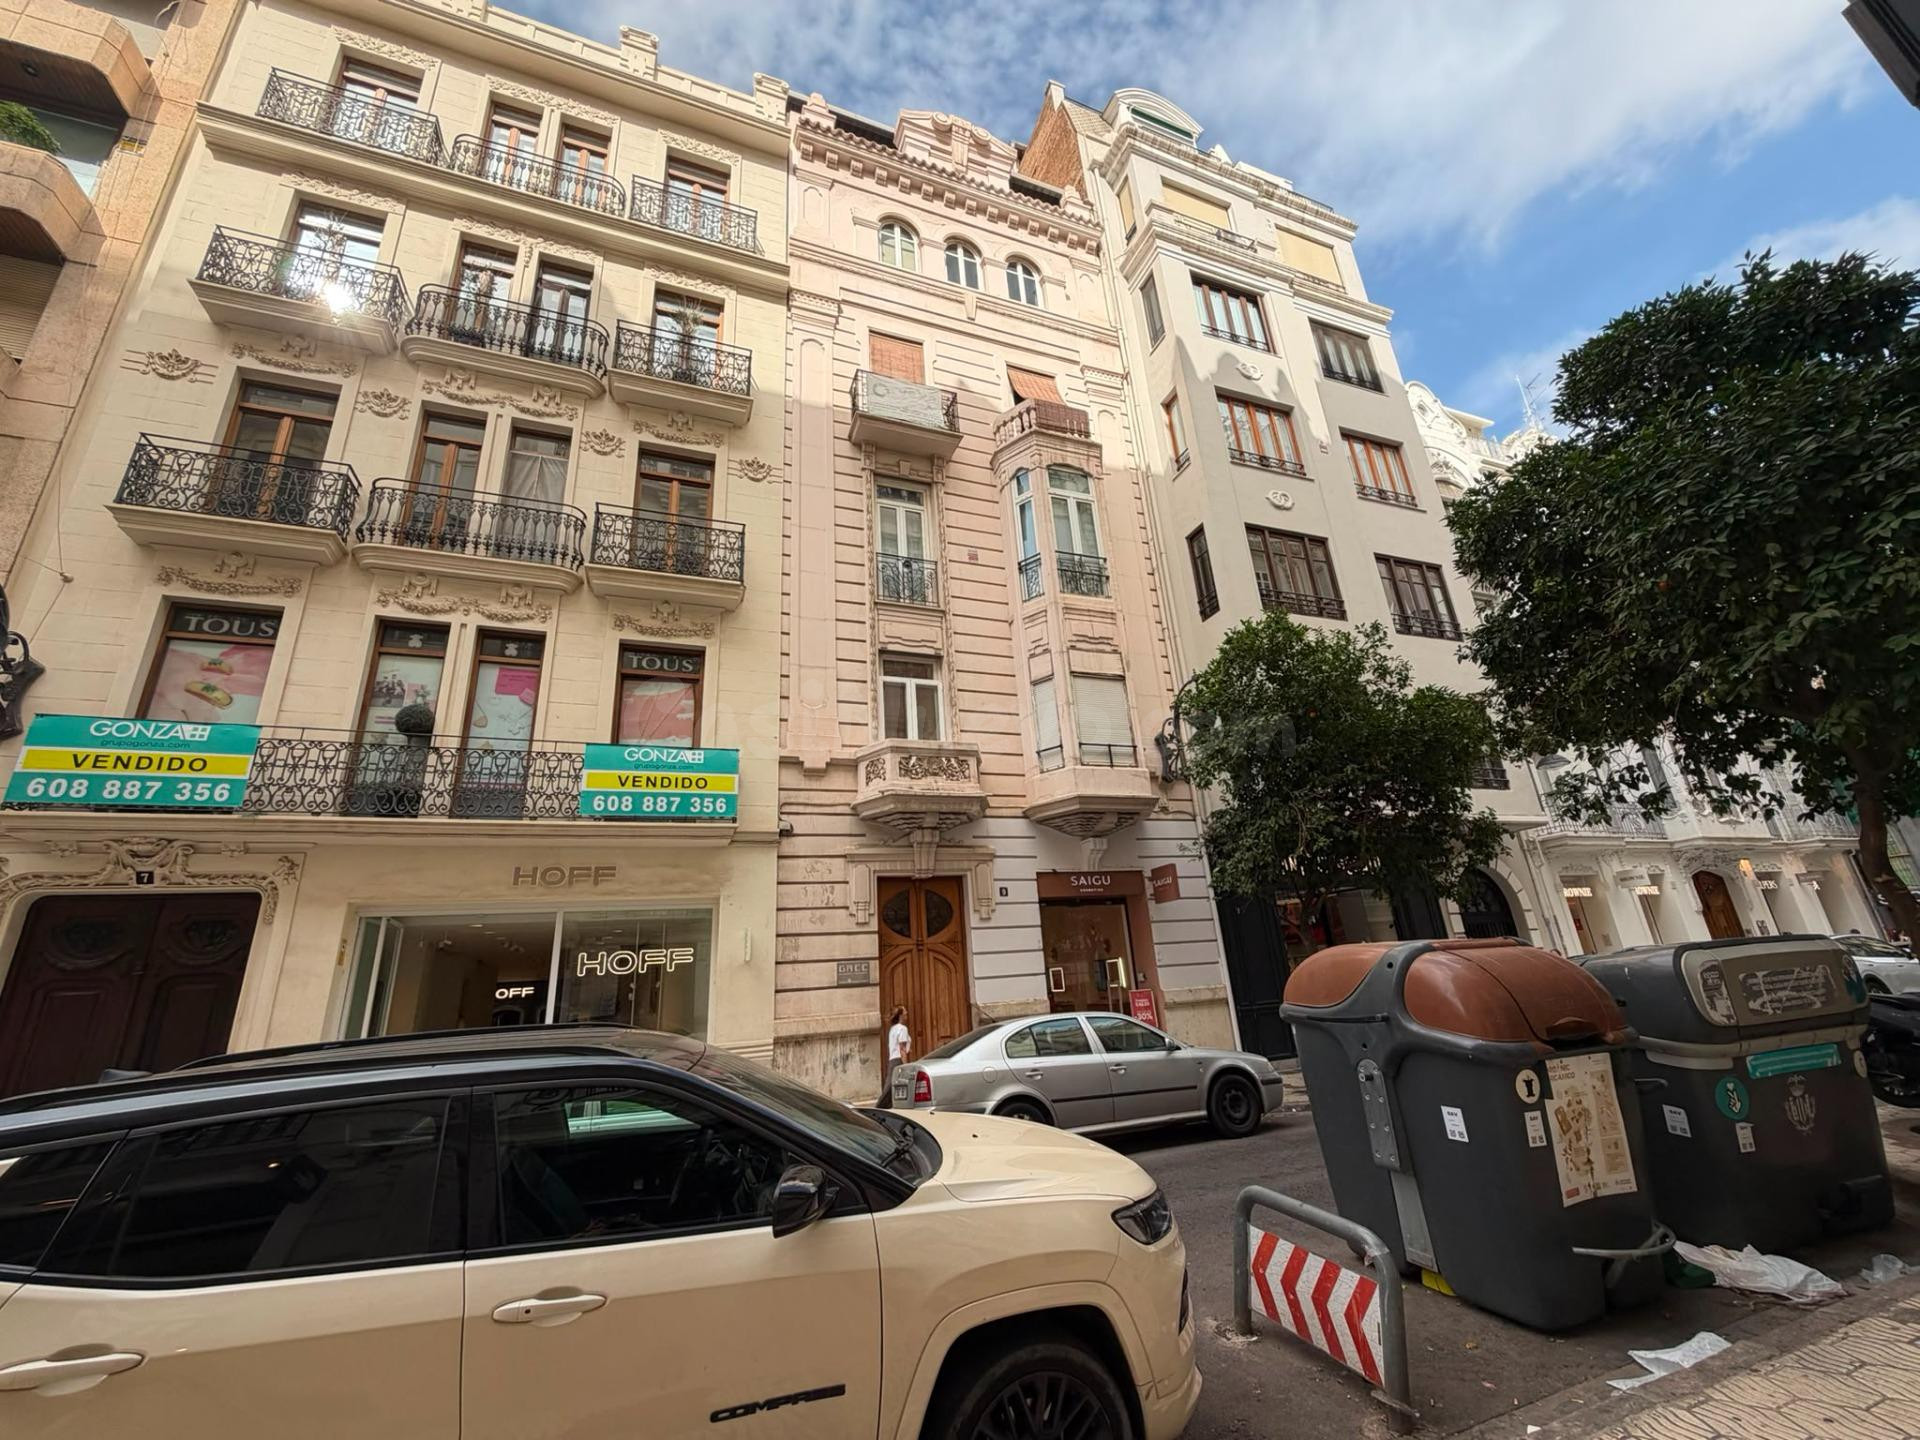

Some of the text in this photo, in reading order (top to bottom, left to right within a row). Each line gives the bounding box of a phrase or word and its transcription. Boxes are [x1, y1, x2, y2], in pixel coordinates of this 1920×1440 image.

[184, 615, 276, 637] TOUS
[628, 655, 694, 672] TOUS
[72, 753, 208, 772] VENDIDO
[26, 777, 231, 802] 608 887 356
[617, 775, 708, 789] VENDIDO
[593, 795, 727, 813] 608 887 356
[141, 872, 149, 883] 7
[512, 865, 617, 888] HOFF
[1070, 875, 1111, 886] SAIGU
[1563, 887, 1593, 897] ROWNIE
[577, 948, 694, 977] HOFF
[495, 987, 535, 999] OFF
